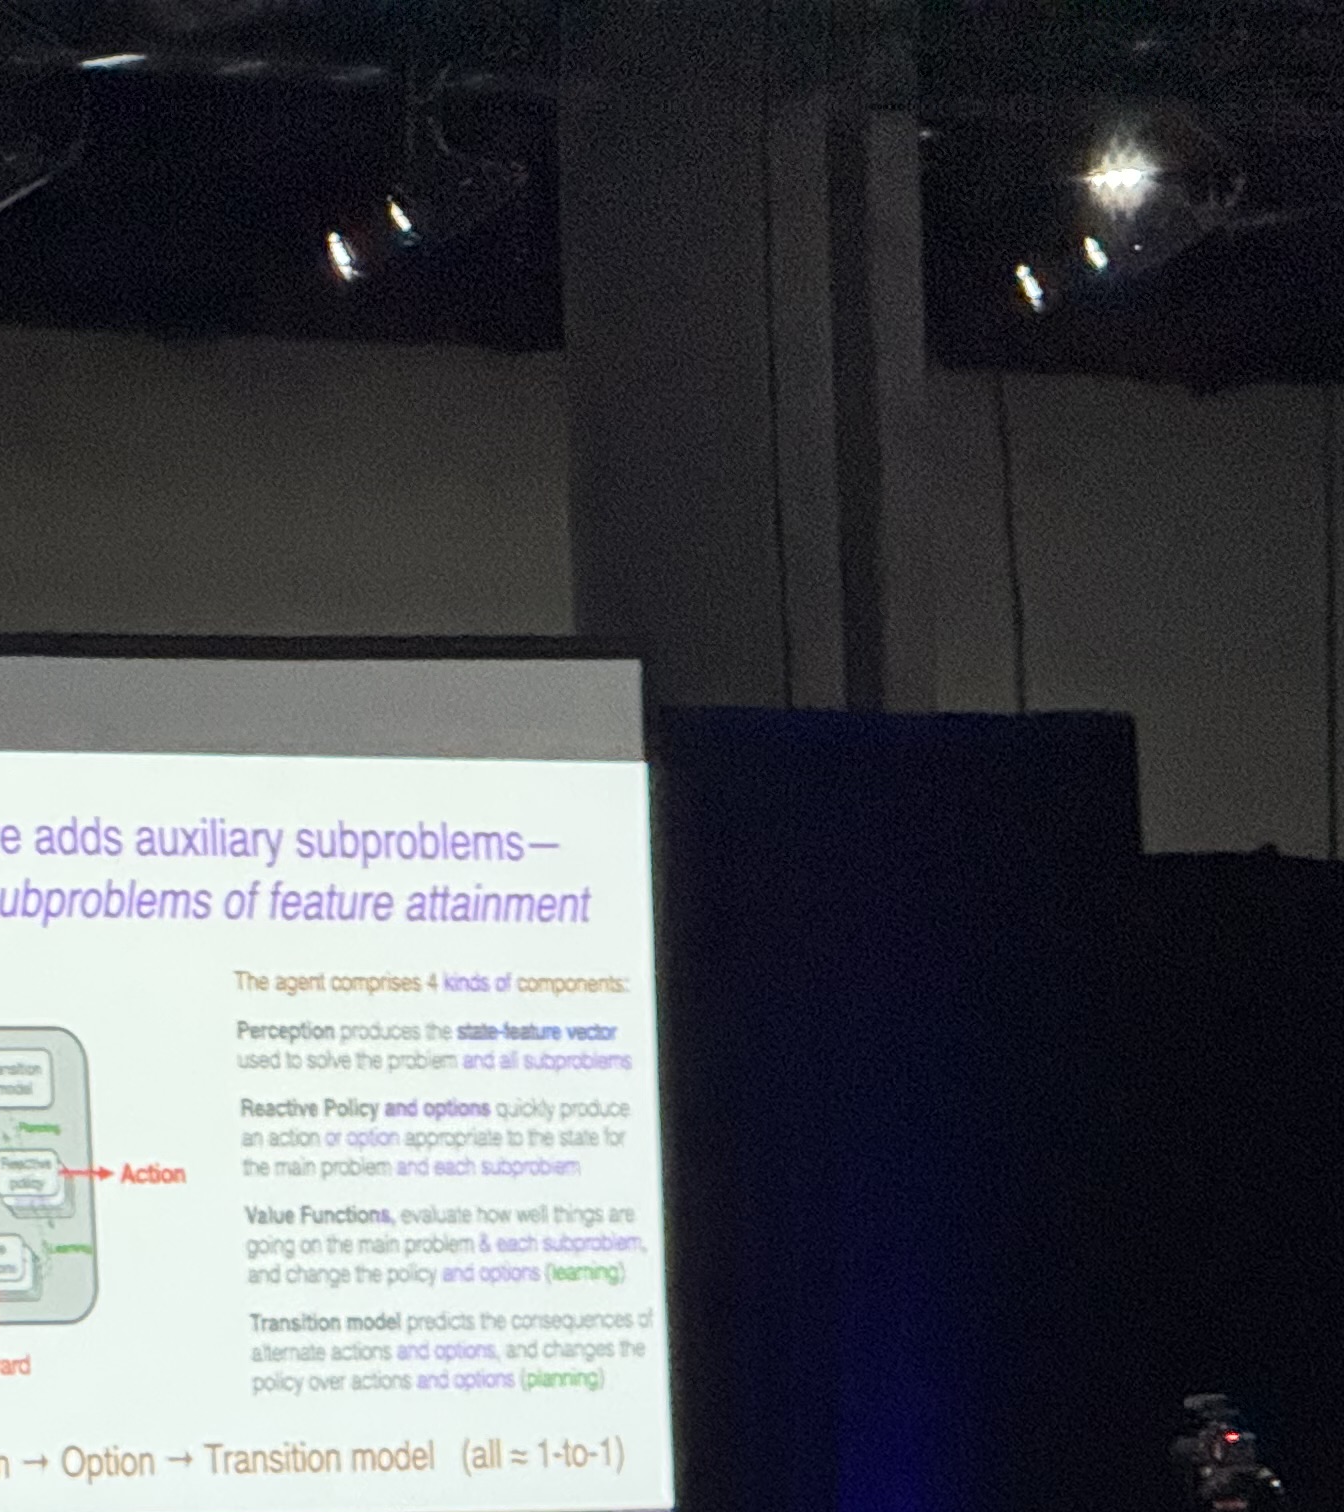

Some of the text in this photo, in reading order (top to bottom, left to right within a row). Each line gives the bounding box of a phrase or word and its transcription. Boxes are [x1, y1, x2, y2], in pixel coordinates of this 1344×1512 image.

[35, 816, 123, 857] adds
[136, 816, 283, 868] auxiliary
[224, 880, 261, 922] of
[269, 880, 394, 922] feature
[406, 884, 592, 923] attainment
[234, 970, 269, 992] The
[275, 972, 326, 995] agent
[331, 974, 422, 996] comprises
[427, 974, 438, 991] 4
[443, 973, 491, 992] kinds
[495, 973, 511, 992] of
[237, 1020, 617, 1045] Perception produces the state-feature vector
[238, 1052, 632, 1074] used to solve the problem and all subproblems
[241, 1099, 630, 1122] Reactive Policy and options quickly produce
[241, 1129, 625, 1151] an action or option appropriate to the state for
[120, 1162, 186, 1185] Action
[242, 1159, 581, 1180] the main problem and each subproblem
[245, 1206, 294, 1225] Value
[401, 1207, 472, 1225] evaluate
[477, 1207, 511, 1225] how
[516, 1206, 548, 1224] well
[553, 1206, 603, 1228] things
[608, 1209, 634, 1224] are
[246, 1237, 295, 1259] going
[301, 1238, 321, 1254] on
[326, 1236, 352, 1254] the
[358, 1236, 400, 1254] main
[405, 1236, 475, 1258] problem
[480, 1234, 491, 1253] &
[497, 1234, 537, 1253] each
[249, 1262, 626, 1288] and change the policy and options (learning)
[250, 1309, 653, 1334] Transition model predicts the consequences of
[252, 1340, 645, 1364] alternate actions and options, and changes the
[253, 1370, 605, 1396] policy over actions and options (planning)
[61, 1444, 154, 1484] Option
[203, 1441, 342, 1474] Transition
[352, 1439, 435, 1472] model
[461, 1436, 503, 1477] (all
[538, 1435, 626, 1474] 1-to-1)
